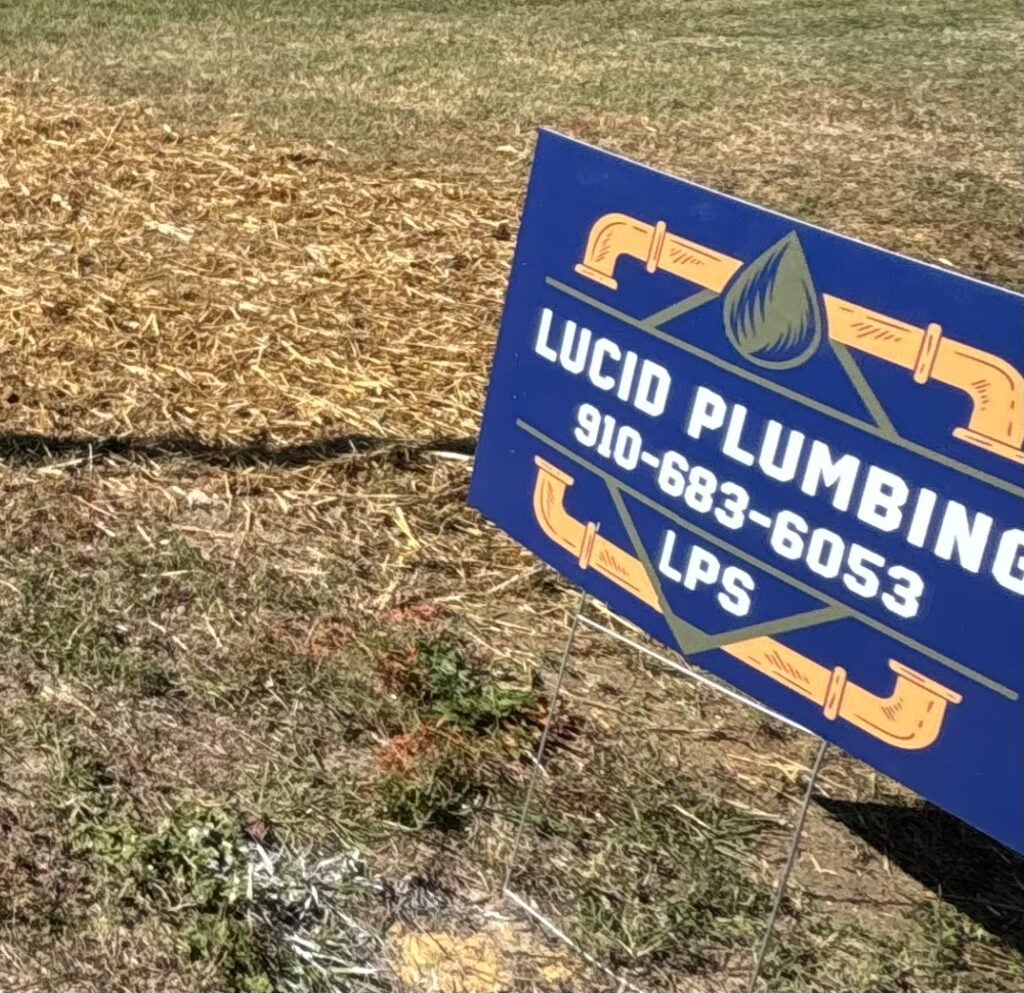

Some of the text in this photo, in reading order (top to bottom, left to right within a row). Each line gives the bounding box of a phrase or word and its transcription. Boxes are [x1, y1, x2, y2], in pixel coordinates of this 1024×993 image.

[534, 307, 1024, 596] LUCID PLUMBING
[573, 403, 925, 619] 910-683-6053
[658, 529, 755, 617] LPS
